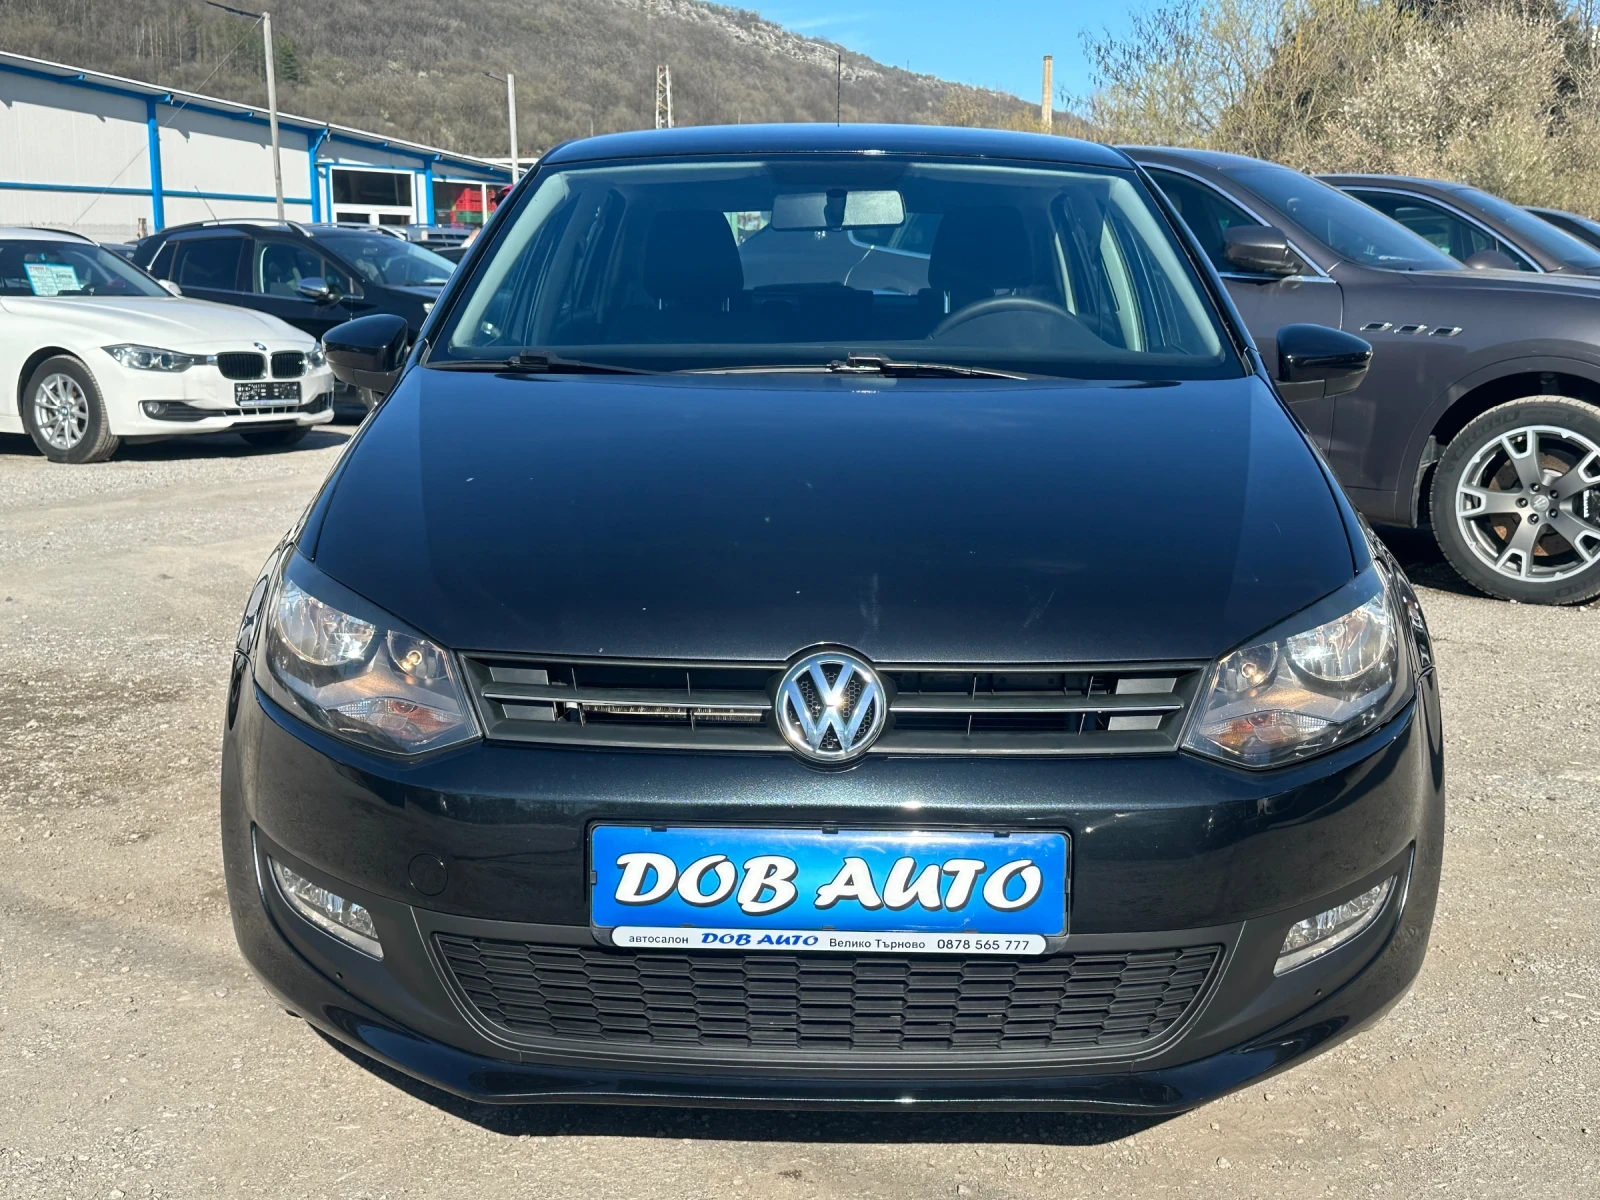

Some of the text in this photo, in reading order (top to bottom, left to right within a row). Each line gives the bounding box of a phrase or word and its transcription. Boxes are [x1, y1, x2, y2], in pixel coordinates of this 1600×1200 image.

[779, 653, 884, 756] VW
[614, 852, 1044, 917] DOB AUTO
[628, 934, 689, 944] автосалон
[701, 932, 819, 946] DOB AUTO
[829, 938, 926, 950] Велико Търново
[937, 939, 1030, 951] 0878 565 777
